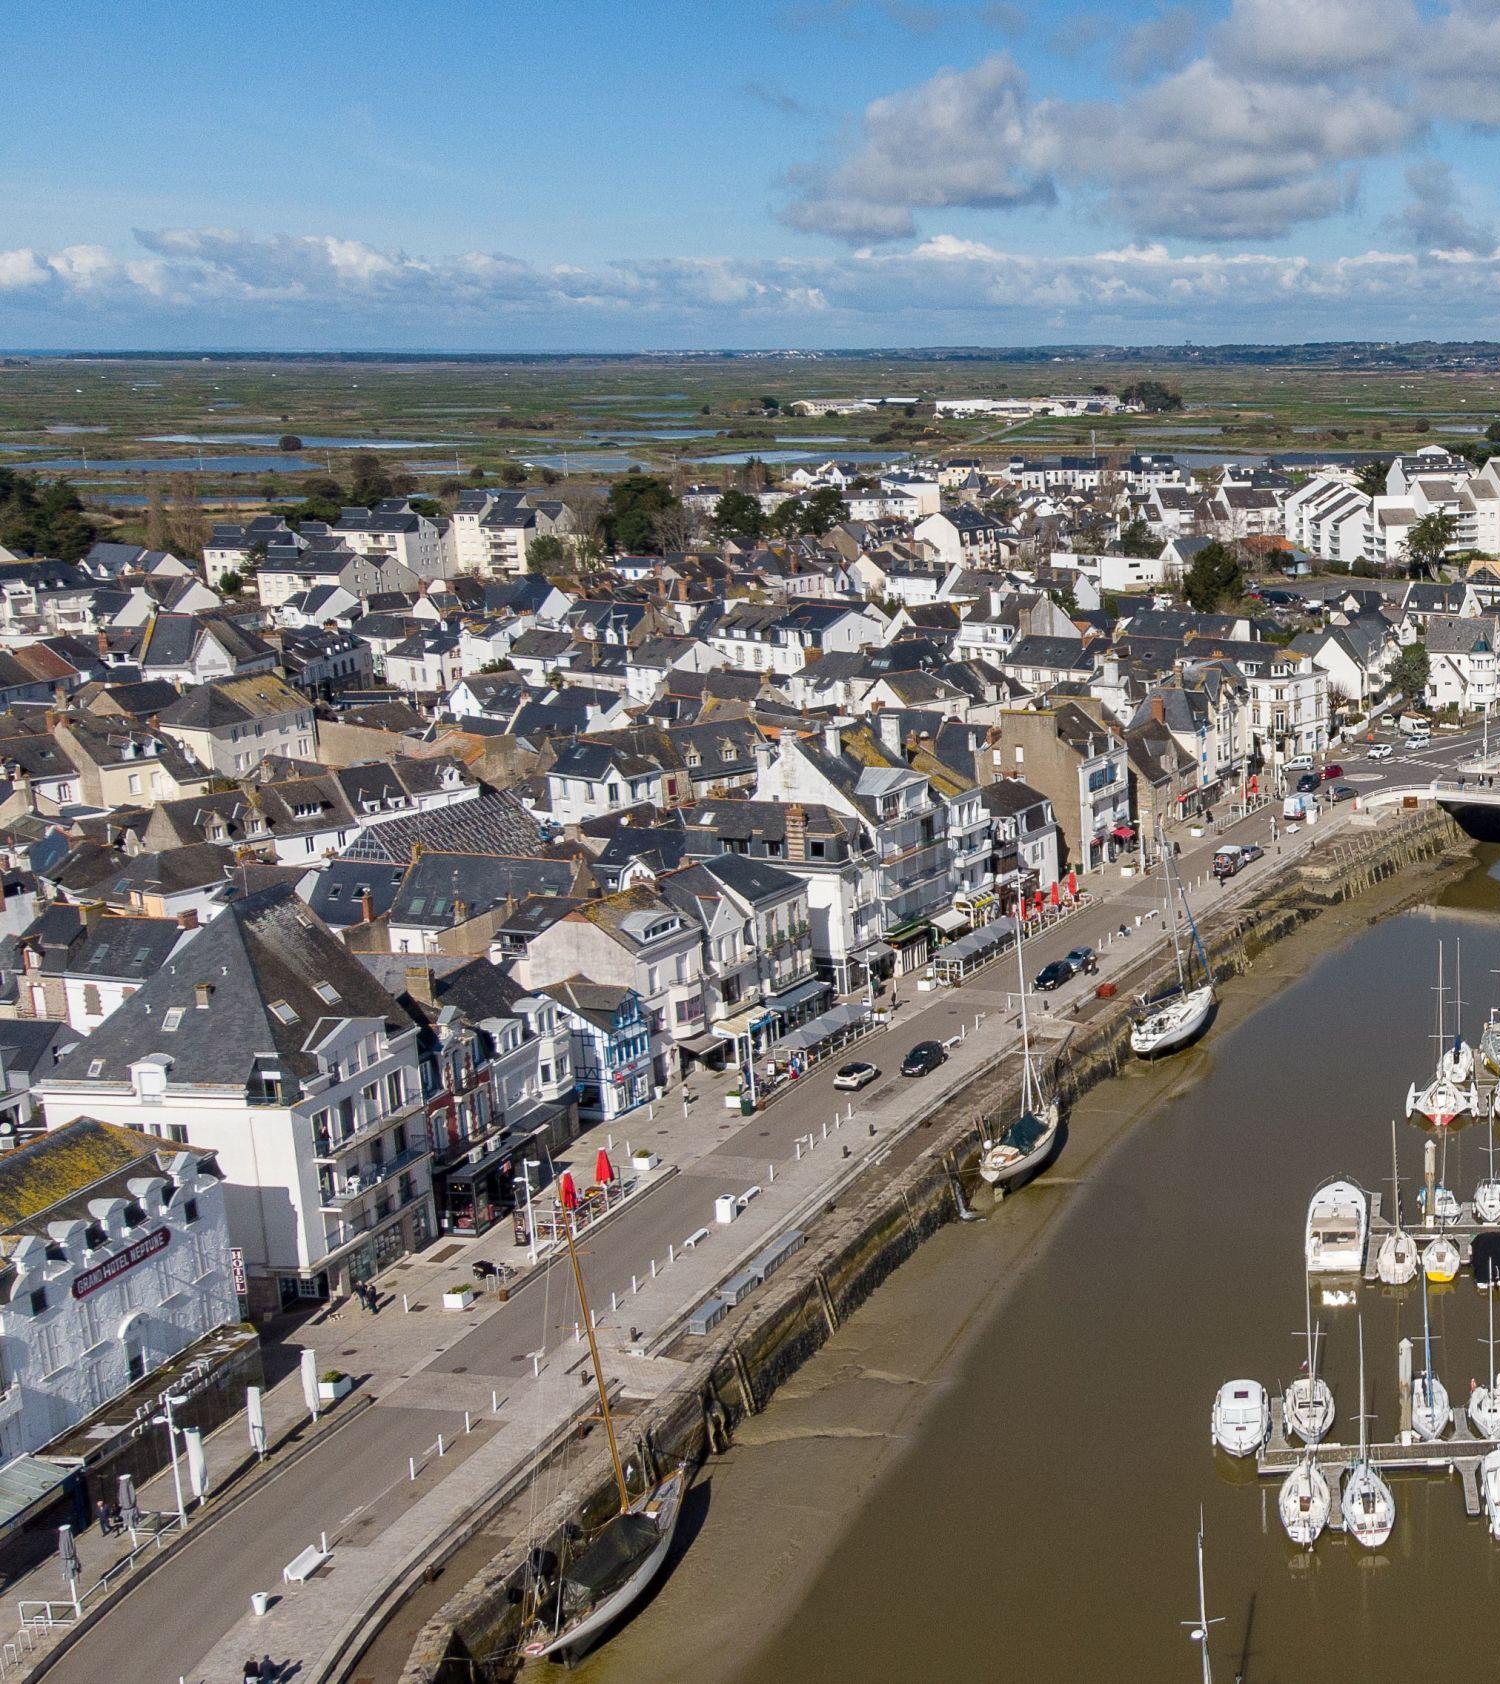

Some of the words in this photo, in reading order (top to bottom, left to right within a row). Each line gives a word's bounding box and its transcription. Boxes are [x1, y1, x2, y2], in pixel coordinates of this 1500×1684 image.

[77, 1269, 103, 1294] GRAND
[103, 1253, 130, 1278] HOTEL
[130, 1232, 165, 1262] NEPTUNE
[231, 1250, 245, 1292] HOTEL
